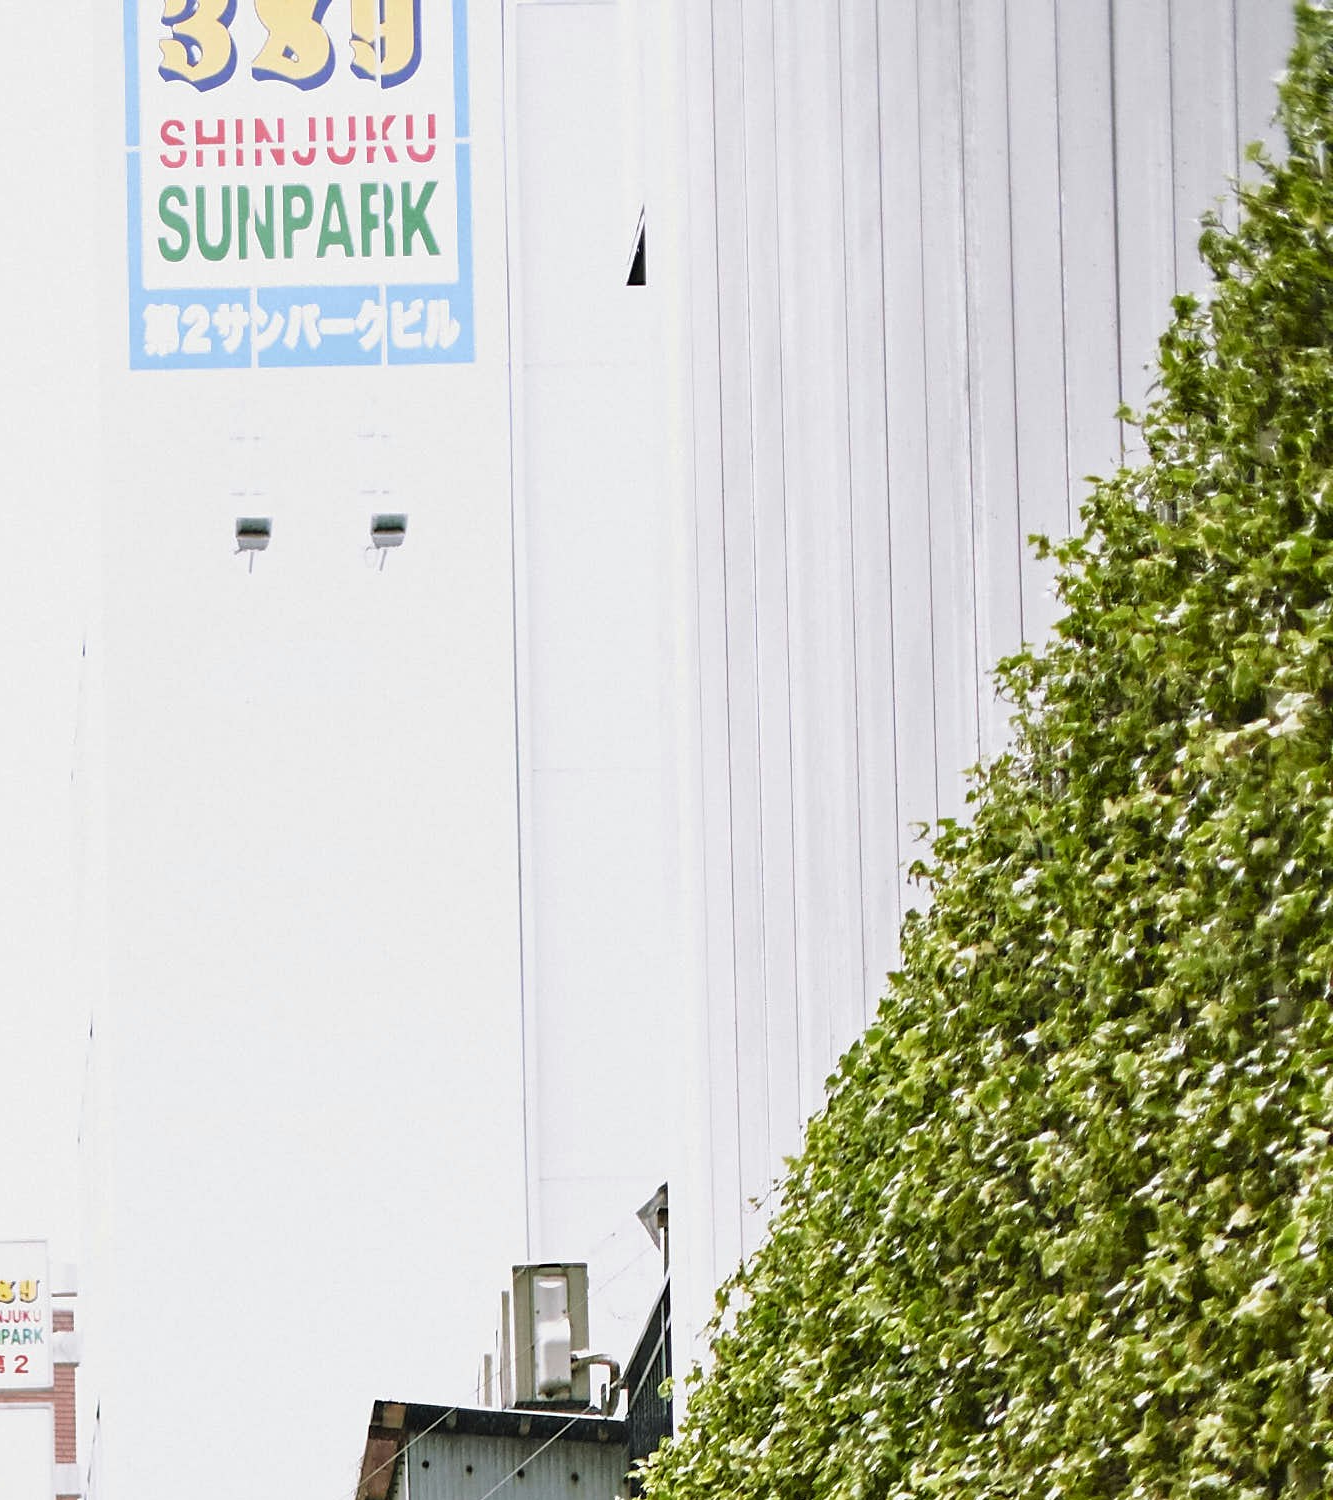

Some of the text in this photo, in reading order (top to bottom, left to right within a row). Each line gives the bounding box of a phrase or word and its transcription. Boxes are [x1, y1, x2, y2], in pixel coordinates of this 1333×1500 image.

[159, 113, 436, 168] SHINJUKU
[158, 180, 441, 262] SUNPARK
[142, 299, 460, 357] 第2サンパークビル
